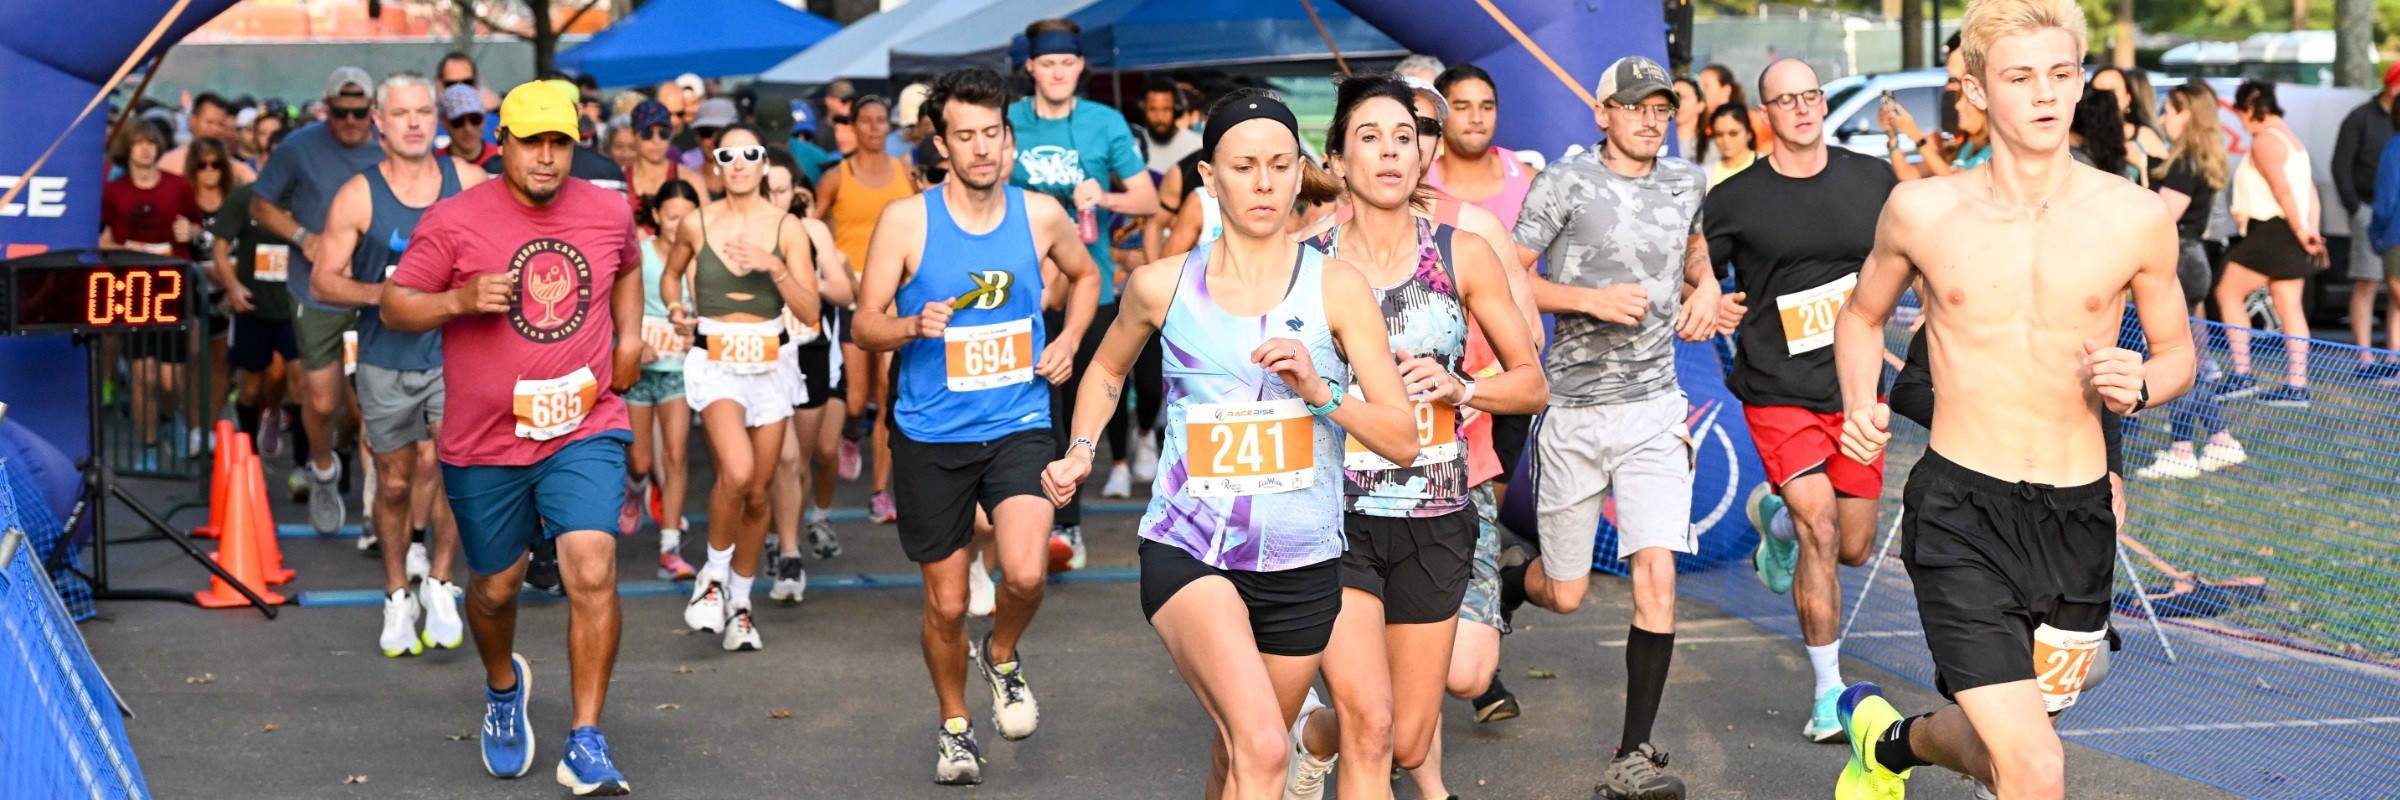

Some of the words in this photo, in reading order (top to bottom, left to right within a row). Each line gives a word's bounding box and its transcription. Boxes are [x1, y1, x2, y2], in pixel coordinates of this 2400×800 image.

[511, 241, 548, 283] CABERNET
[553, 243, 589, 277] CANTER
[88, 270, 182, 324] 0:02
[513, 315, 545, 340] TALON
[551, 309, 584, 339] WINERY
[720, 334, 765, 361] 288
[965, 336, 1017, 376] 694
[532, 388, 582, 427] 685
[1210, 421, 1285, 473] 241
